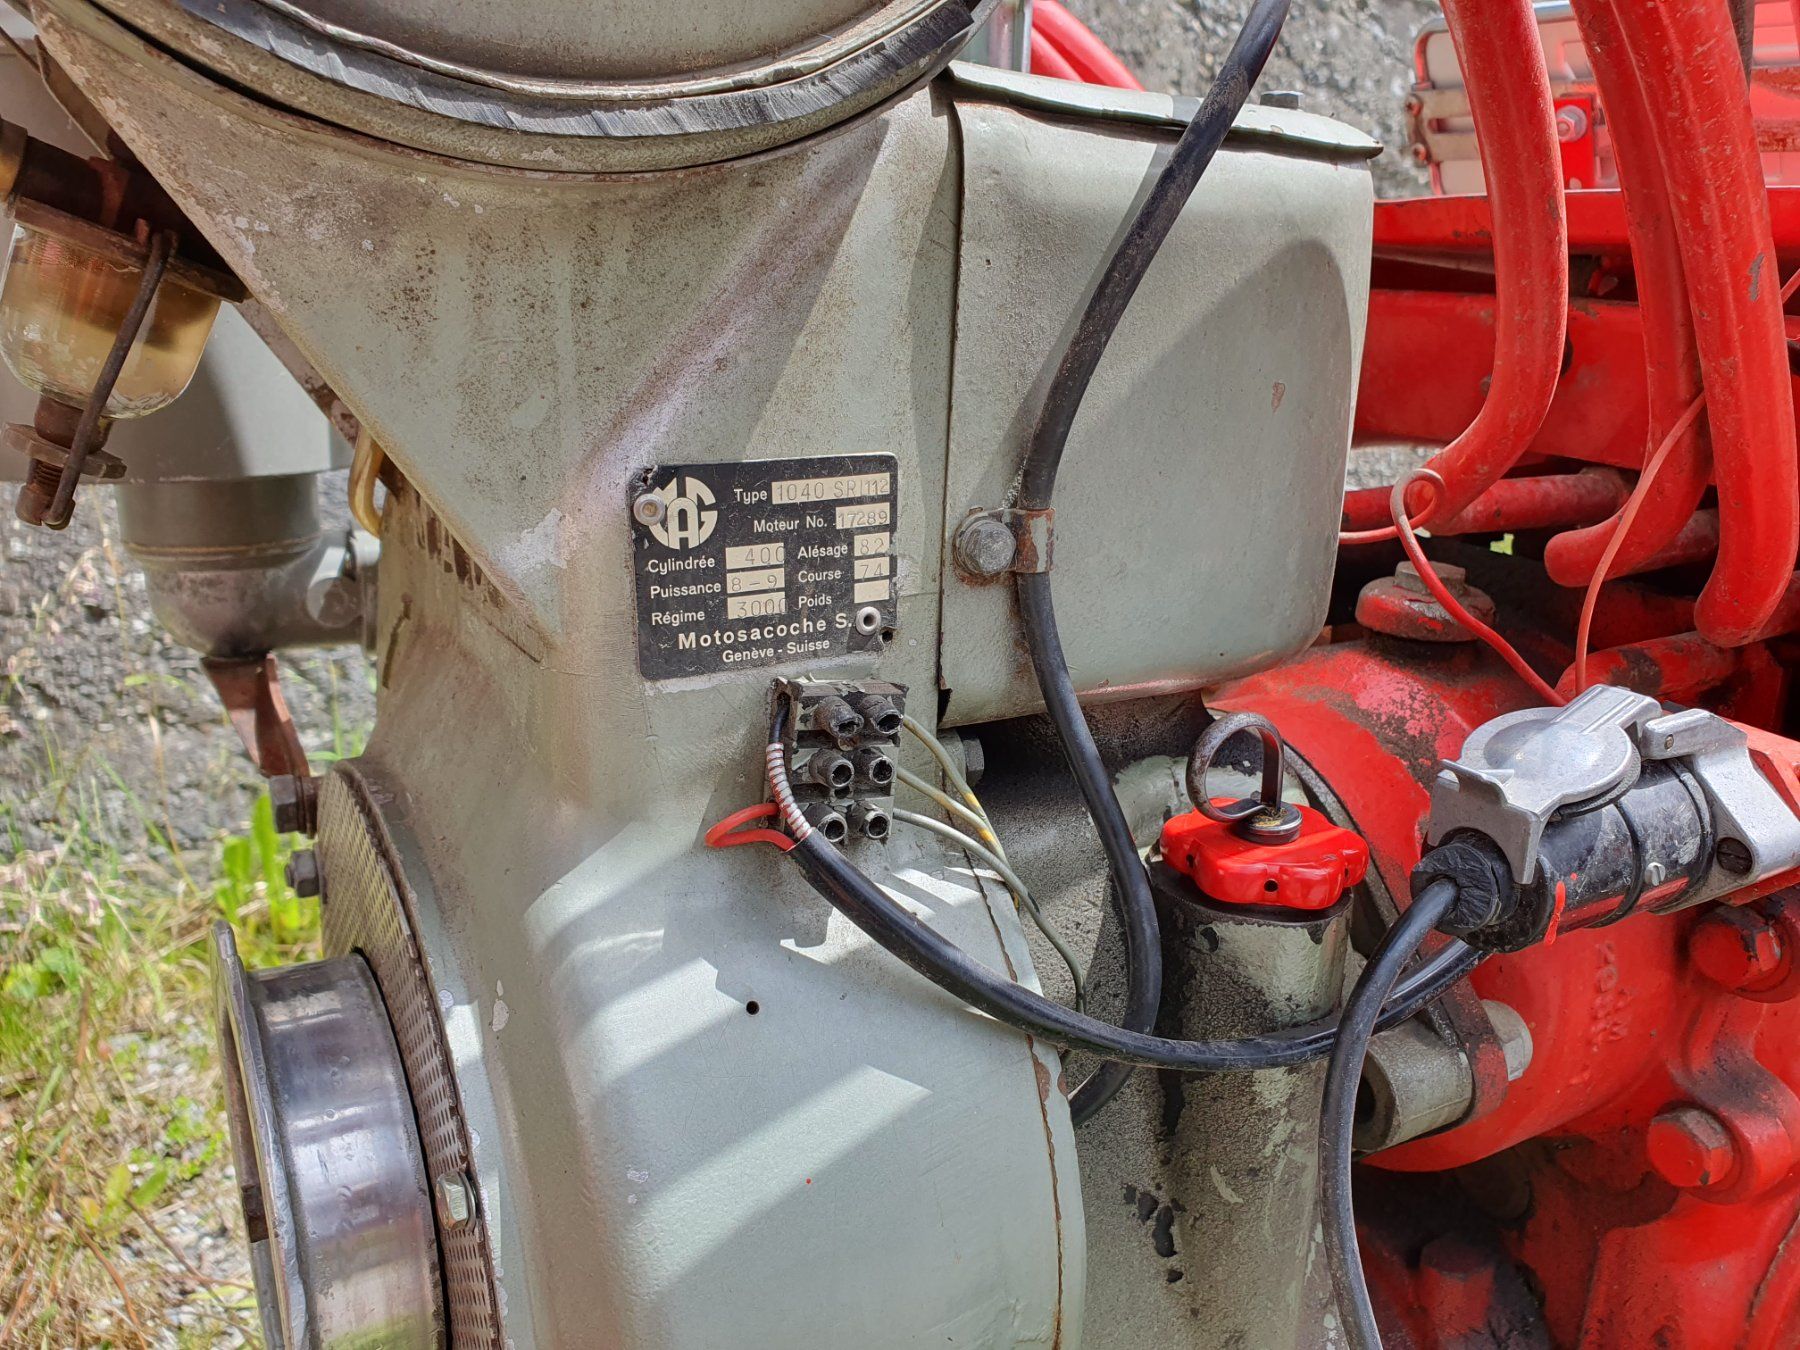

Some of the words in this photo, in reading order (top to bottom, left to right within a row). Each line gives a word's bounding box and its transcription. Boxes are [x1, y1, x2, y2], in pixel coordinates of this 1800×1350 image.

[734, 488, 768, 504] Type
[777, 482, 825, 501] 1040
[753, 518, 800, 533] Moteur
[805, 515, 828, 529] No.
[838, 510, 888, 528] 17289
[797, 544, 848, 560] Alésage
[860, 538, 884, 555] 82
[648, 554, 716, 575] Cylindrée
[798, 569, 842, 583] Course
[859, 562, 884, 580] 74
[650, 582, 722, 599] Puissance
[798, 594, 832, 609] Poids
[651, 610, 706, 627] Régime
[678, 616, 827, 650] Motosacoche
[722, 647, 774, 664] Genève
[786, 639, 830, 655] Suisse
